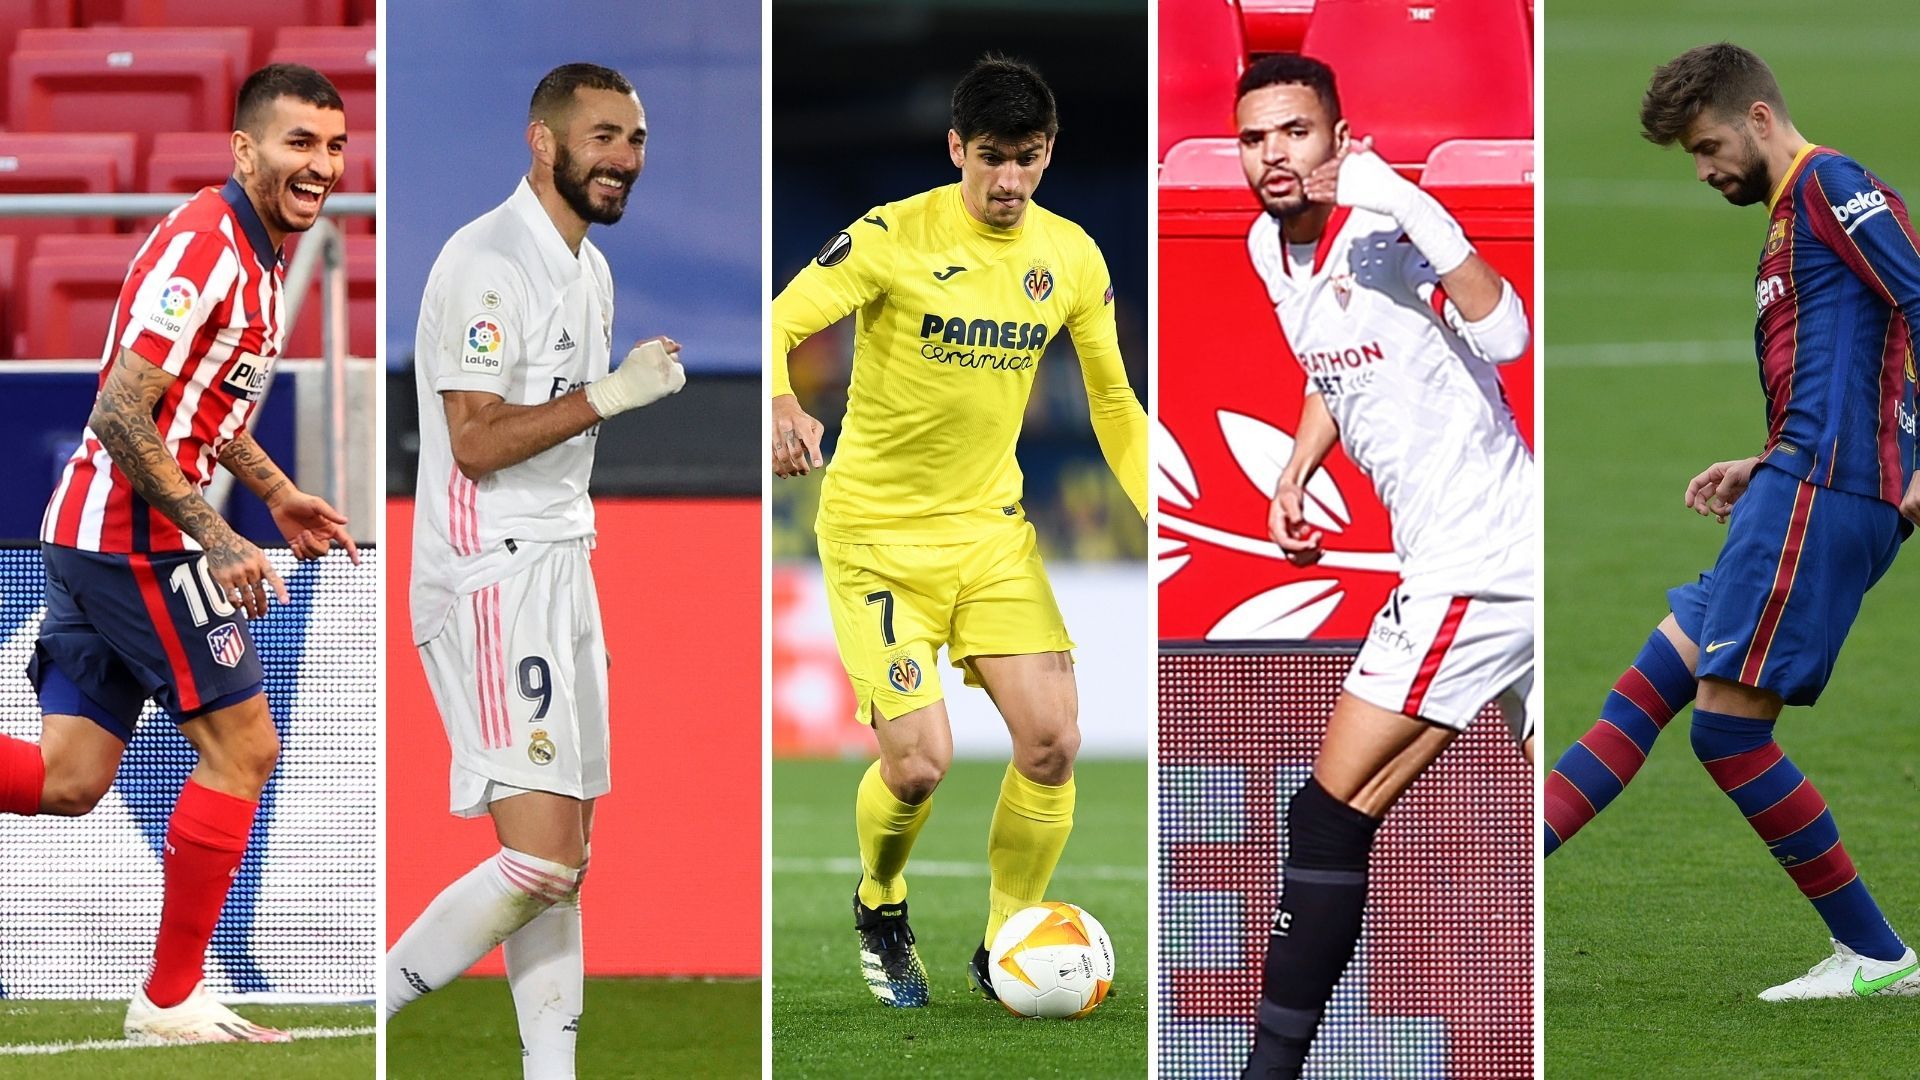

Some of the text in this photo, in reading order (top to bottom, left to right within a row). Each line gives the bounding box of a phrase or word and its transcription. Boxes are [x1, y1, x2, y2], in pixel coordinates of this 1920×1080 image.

[1831, 190, 1886, 222] beko
[150, 313, 181, 333] LaLiga
[920, 313, 1048, 351] PAMESA
[465, 355, 499, 368] LaLiga
[921, 344, 1033, 371] cerámica
[169, 555, 236, 628] 10
[864, 590, 897, 648] 7
[515, 656, 552, 723] 9
